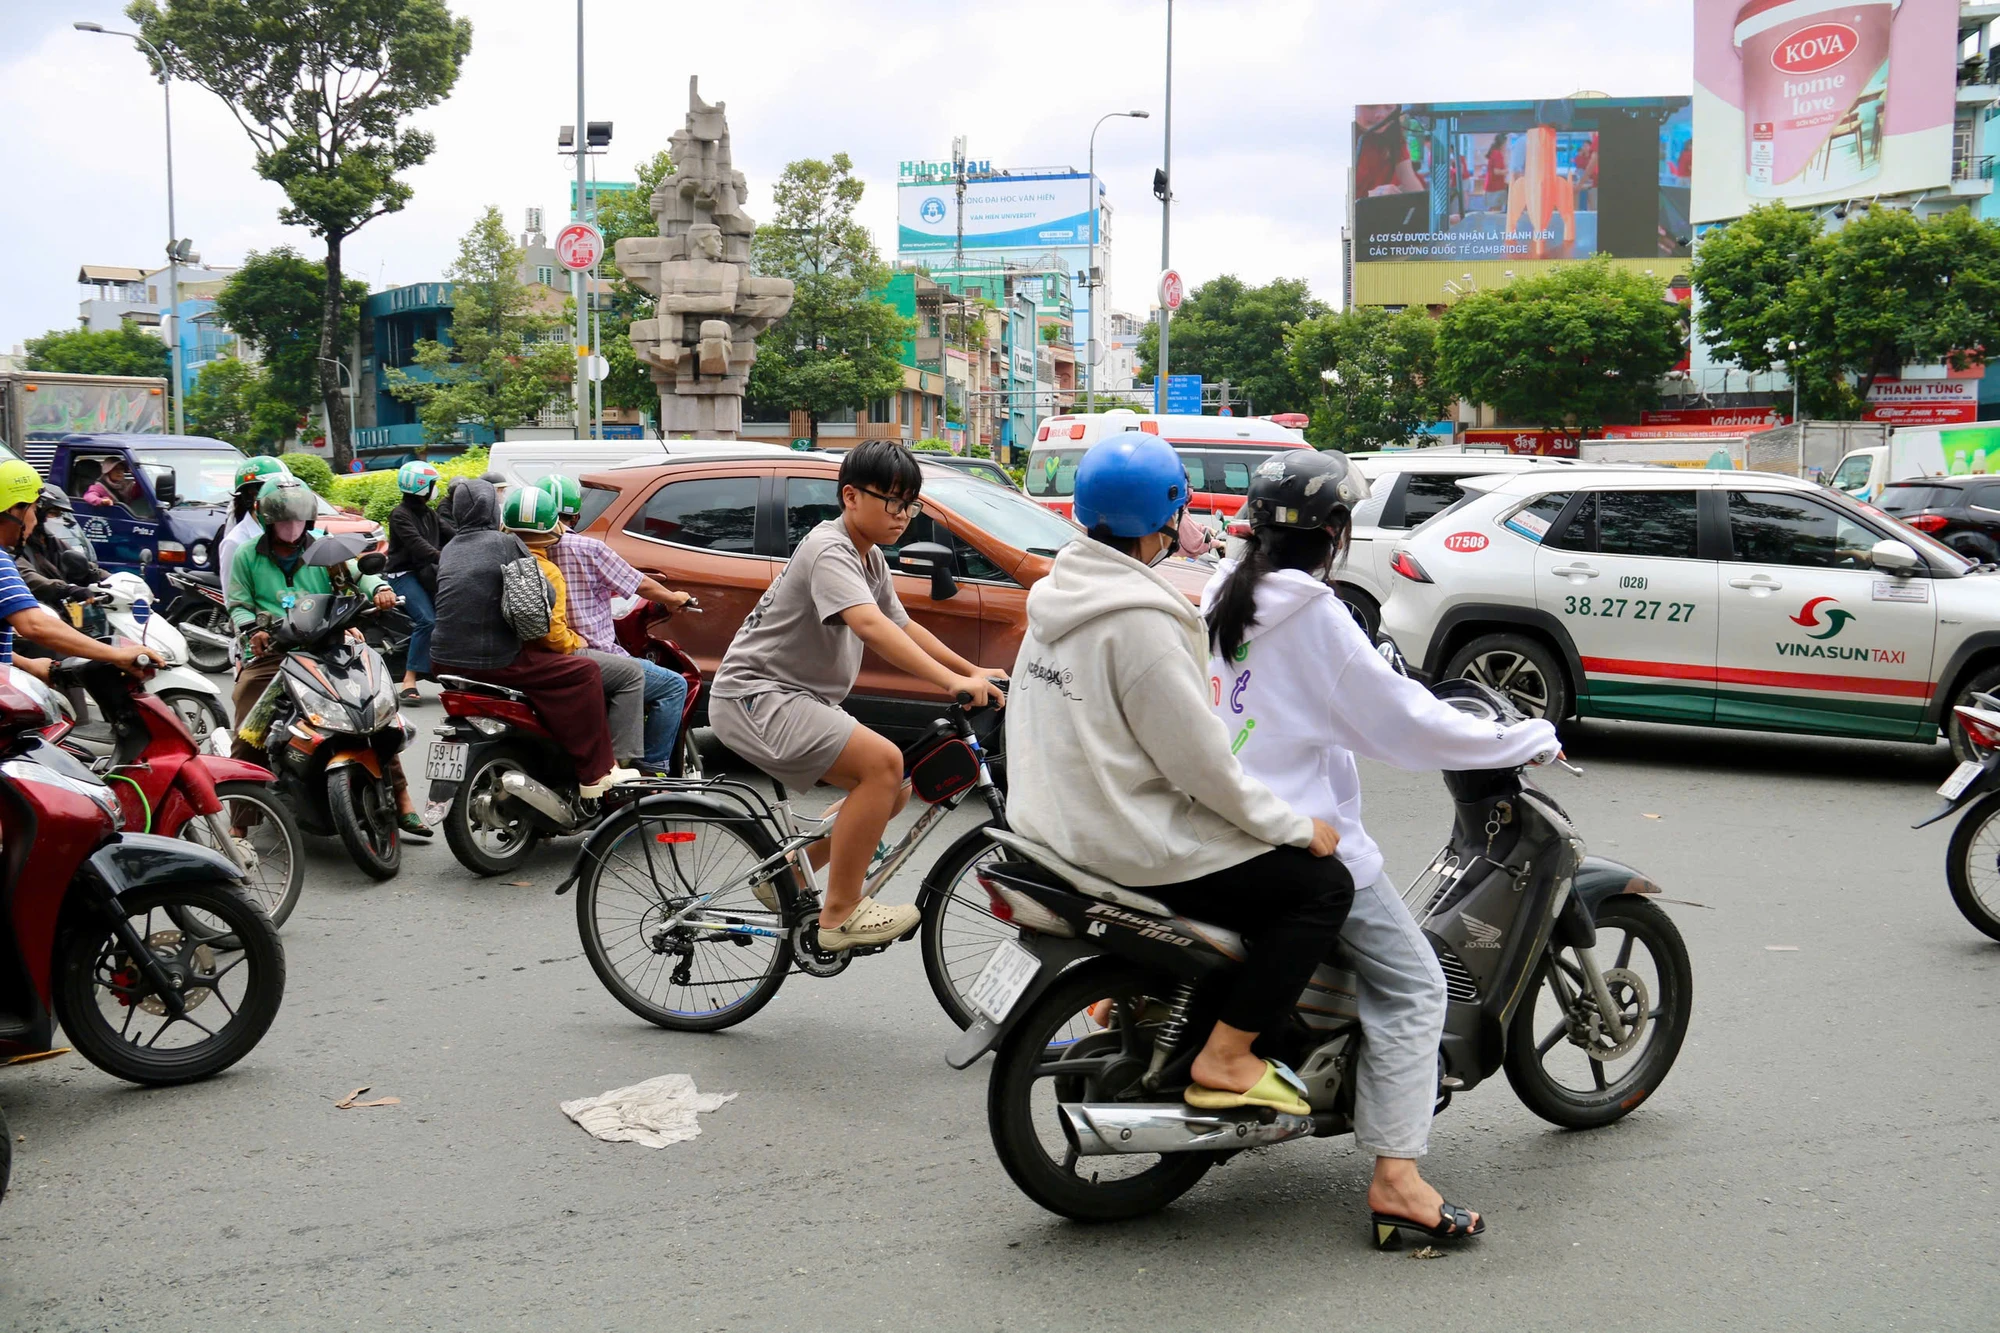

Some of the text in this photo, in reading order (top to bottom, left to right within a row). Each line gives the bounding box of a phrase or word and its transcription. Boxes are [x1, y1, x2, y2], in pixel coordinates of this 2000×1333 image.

[1784, 34, 1845, 64] KOVA
[1783, 75, 1845, 98] home
[1792, 96, 1835, 116] love
[1369, 230, 1555, 242] 6 CƠ SỞ ĐƯỢC CÔNG NHẬN LÀ THÀNH VIÊN
[1369, 243, 1528, 256] CÁC TRƯỜNG QUỐC TẾ CAMBRIDGE
[1875, 385, 1922, 395] THANH
[1711, 415, 1761, 426] Vietlott
[1449, 536, 1485, 548] 17508
[1619, 576, 1648, 590] (028)
[1564, 596, 1696, 623] 38.27 27 27
[433, 744, 461, 761] 59-L1
[427, 761, 463, 779] 761.76
[1085, 901, 1174, 933] Future
[1464, 941, 1501, 949] ONDA
[974, 973, 1012, 1014] 3749
